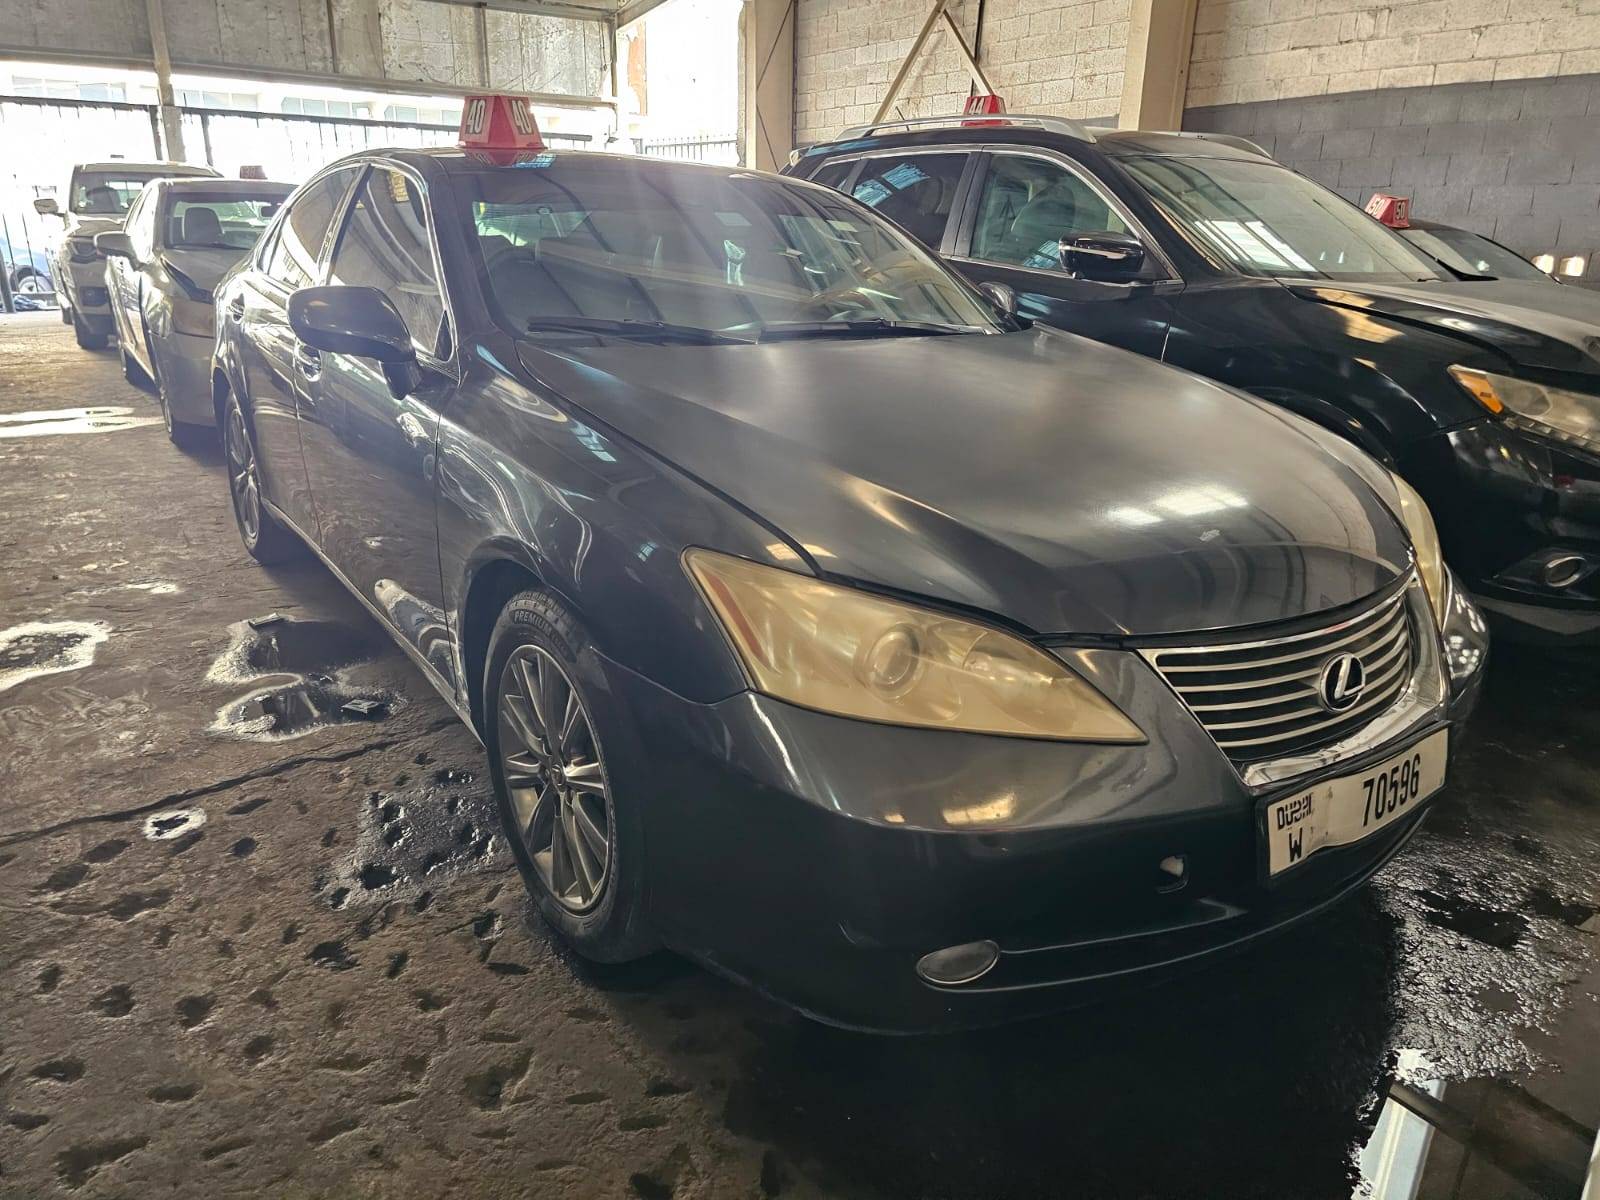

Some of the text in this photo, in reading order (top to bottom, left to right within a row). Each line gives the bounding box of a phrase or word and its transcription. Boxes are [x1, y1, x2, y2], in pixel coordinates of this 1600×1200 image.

[467, 99, 486, 134] 40
[511, 99, 533, 134] 40
[1395, 200, 1407, 220] 50
[514, 610, 553, 636] PREMIUM
[1362, 753, 1421, 827] 70596
[1288, 827, 1303, 863] W
